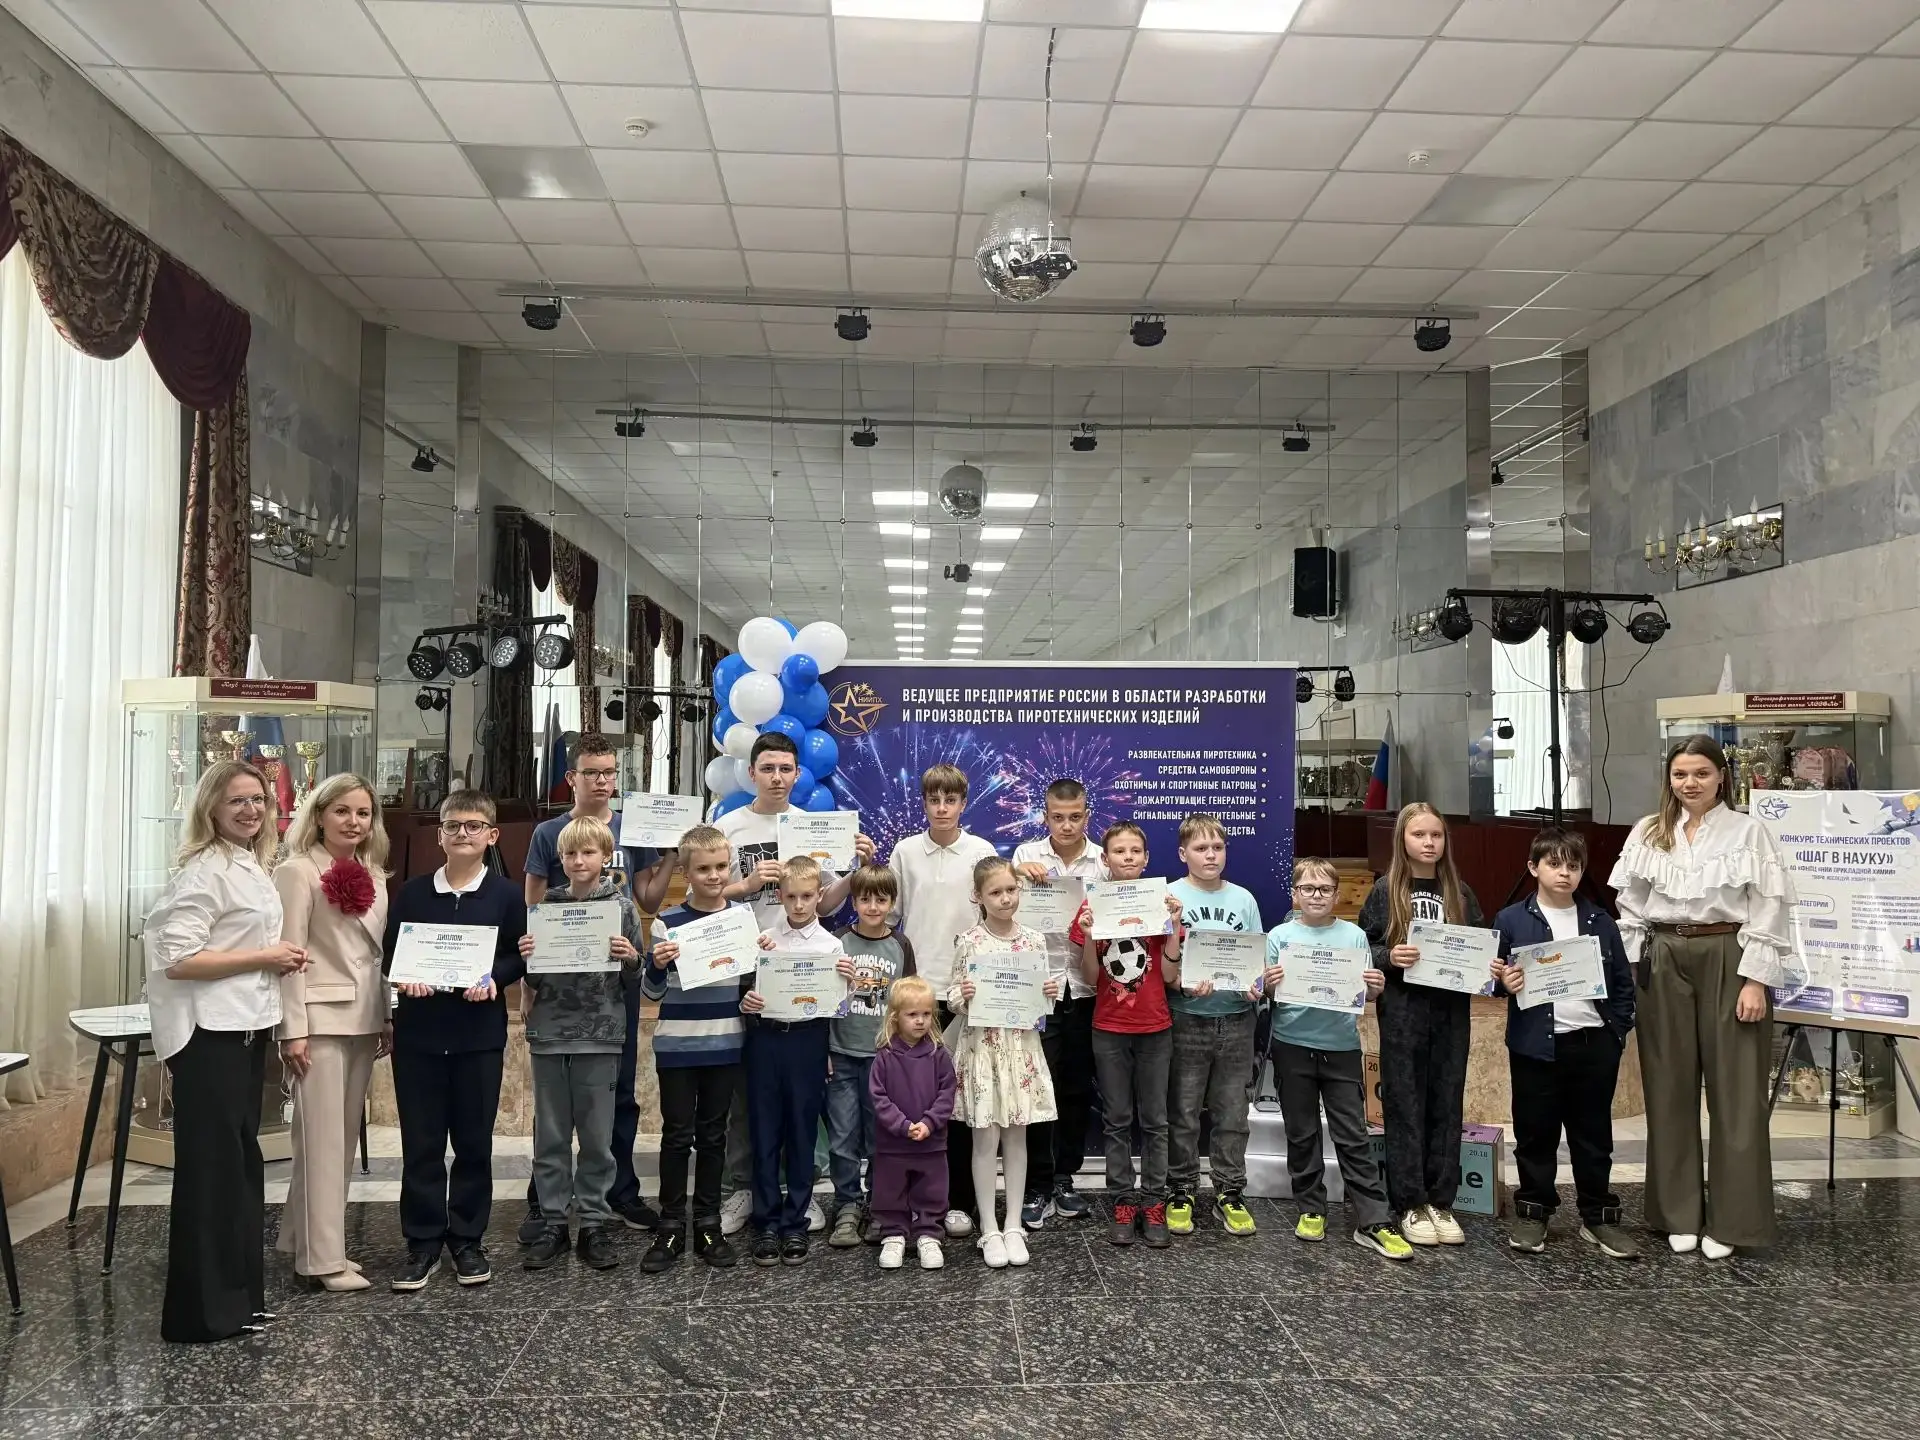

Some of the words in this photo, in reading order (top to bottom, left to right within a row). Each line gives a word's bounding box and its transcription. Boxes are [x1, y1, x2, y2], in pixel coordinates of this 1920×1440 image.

[902, 688, 960, 704] ВЕДУЩЕЕ
[964, 688, 1054, 704] ПРЕДПРИЯТИЕ
[1059, 689, 1107, 703] РОССИИ
[1112, 689, 1120, 703] В
[1124, 689, 1181, 703] ОБЛАСТИ
[1185, 690, 1266, 704] РАЗРАБОТКИ
[902, 709, 910, 723] И
[915, 709, 1014, 724] ПРОИЗВОДСТВА
[1018, 709, 1138, 723] ПИРОТЕХНИЧЕСКИХ
[1142, 706, 1200, 725] ИЗДЕЛИЙ
[1128, 750, 1201, 759] РАЗВЛЕКАТЕЛЬНАЯ
[1203, 750, 1257, 759] ПИРОТЕХНИКА
[1158, 766, 1197, 775] СРЕДСТВА
[1200, 766, 1257, 774] САМООБОРОНЫ
[1114, 781, 1158, 789] ОХОТНИЧЬИ
[1161, 781, 1165, 789] И
[1168, 781, 1219, 789] СПОРТИВНЫЕ
[1221, 781, 1257, 789] ПАТРОНЫ
[1137, 796, 1206, 805] ПОЖАРОТУШАЩИЕ
[1209, 796, 1256, 805] ГЕНЕРАТОРЫ
[1133, 811, 1182, 820] СИГНАЛЬНЫЕ
[1193, 811, 1256, 820] ЕТИТЕЛЬНЫЕ
[1780, 834, 1814, 843] КОНКУРС
[1815, 835, 1870, 845] ТЕХНИЧЕСКИХ
[1871, 837, 1911, 845] ПРОЕКТОВ
[1795, 850, 1829, 862] «ШАГ
[1831, 851, 1840, 863] В
[1843, 852, 1894, 865] НАУКУ»
[1799, 899, 1829, 908] АТЕГОРИИ
[1181, 906, 1244, 931] SUMMER
[1804, 939, 1850, 950] НАПРАВЛЕНИЯ
[1368, 1062, 1378, 1072] 20
